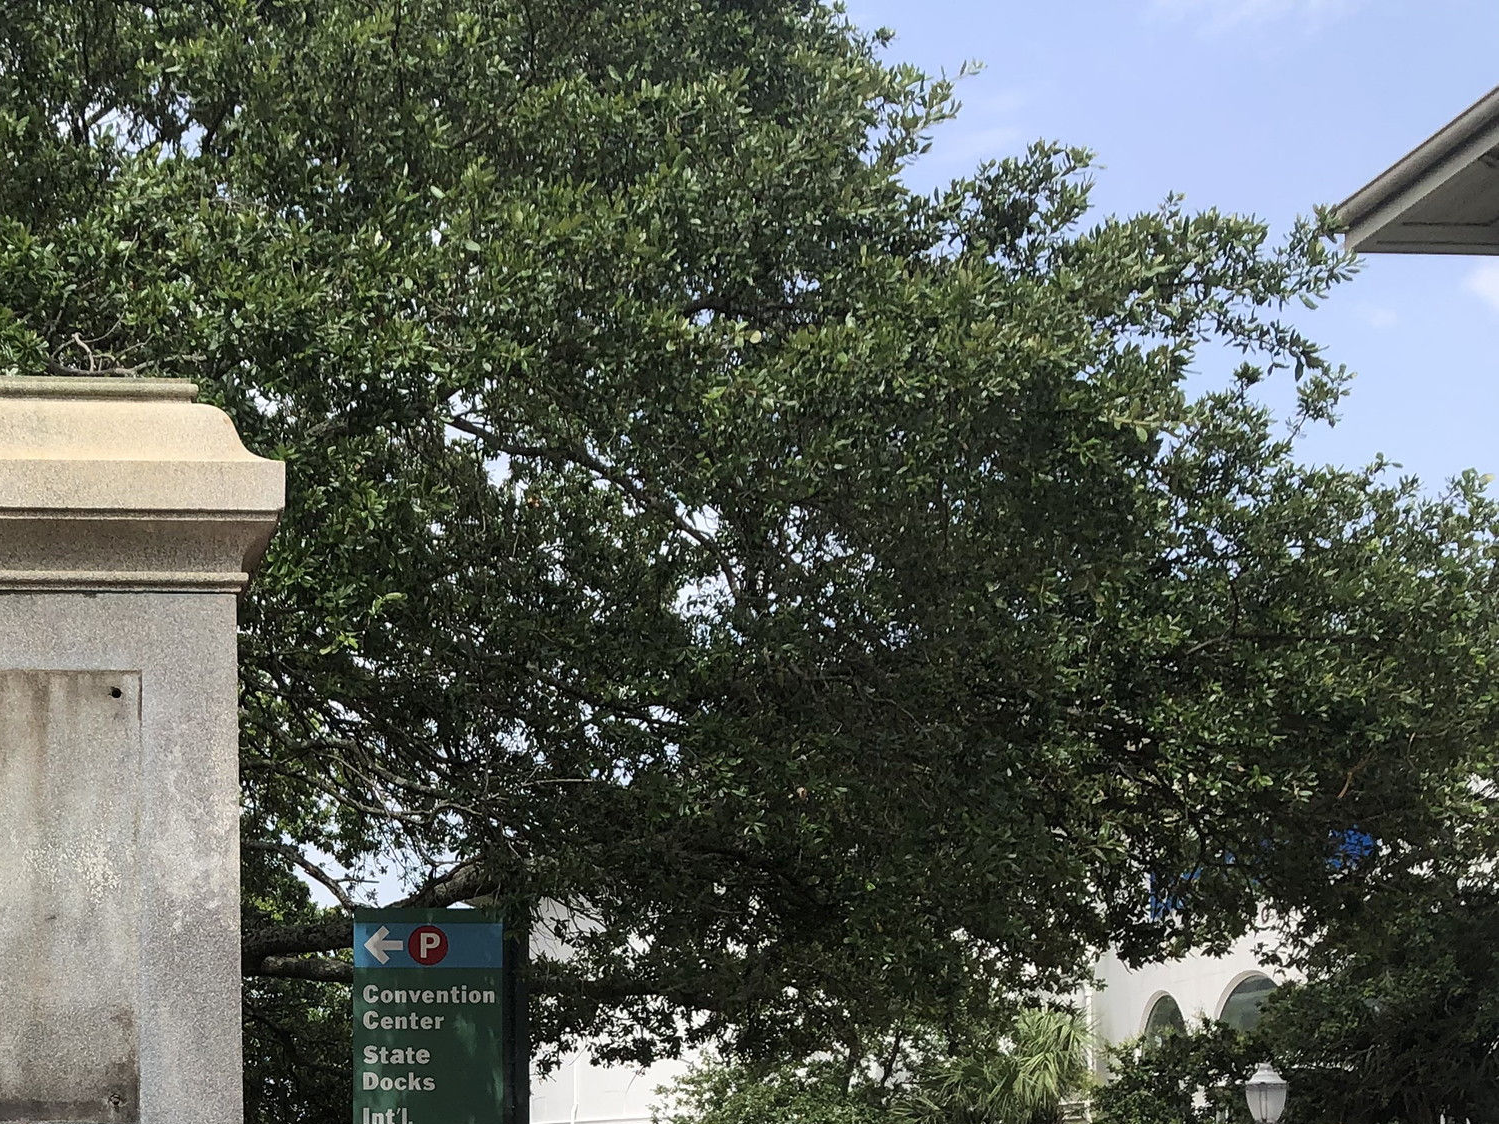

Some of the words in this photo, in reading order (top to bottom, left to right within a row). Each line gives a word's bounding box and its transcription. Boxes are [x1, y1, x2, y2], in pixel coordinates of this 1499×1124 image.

[420, 932, 441, 959] P
[362, 984, 496, 1004] Convention
[362, 1010, 445, 1030] Center
[362, 1045, 431, 1065] State
[362, 1071, 437, 1091] Docks
